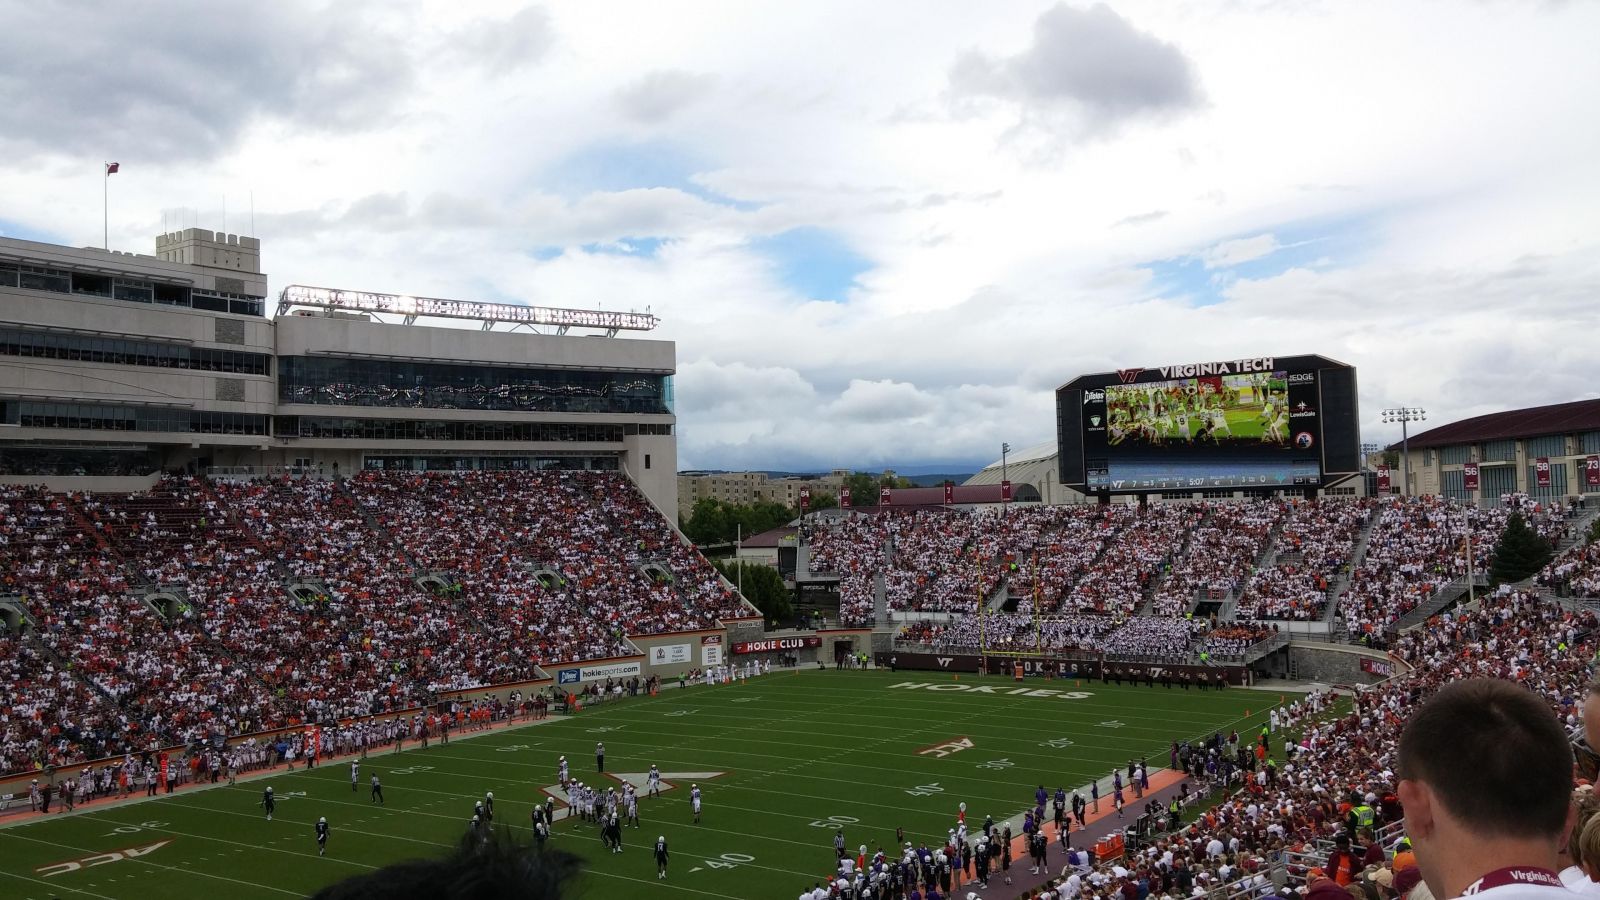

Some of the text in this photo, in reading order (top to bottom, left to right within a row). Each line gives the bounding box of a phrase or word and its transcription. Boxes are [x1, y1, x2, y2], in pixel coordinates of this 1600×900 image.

[1160, 357, 1274, 378] VIRGINIA TECH
[1116, 367, 1144, 383] VT
[1465, 467, 1478, 476] 56
[1536, 462, 1549, 471] 58
[1587, 460, 1599, 470] 73
[1377, 469, 1389, 478] 64
[1189, 477, 1204, 486] 5:07
[881, 488, 890, 496] 25
[747, 638, 804, 651] HOKIE CLUB
[937, 657, 954, 667] VT
[1371, 660, 1390, 676] HOKIE
[582, 666, 638, 678] hokiesports.com
[888, 682, 1096, 700] HOKIES
[904, 783, 946, 797] 40
[808, 815, 861, 830] 50
[704, 853, 756, 870] 40
[1509, 870, 1562, 886] VirginiaTec
